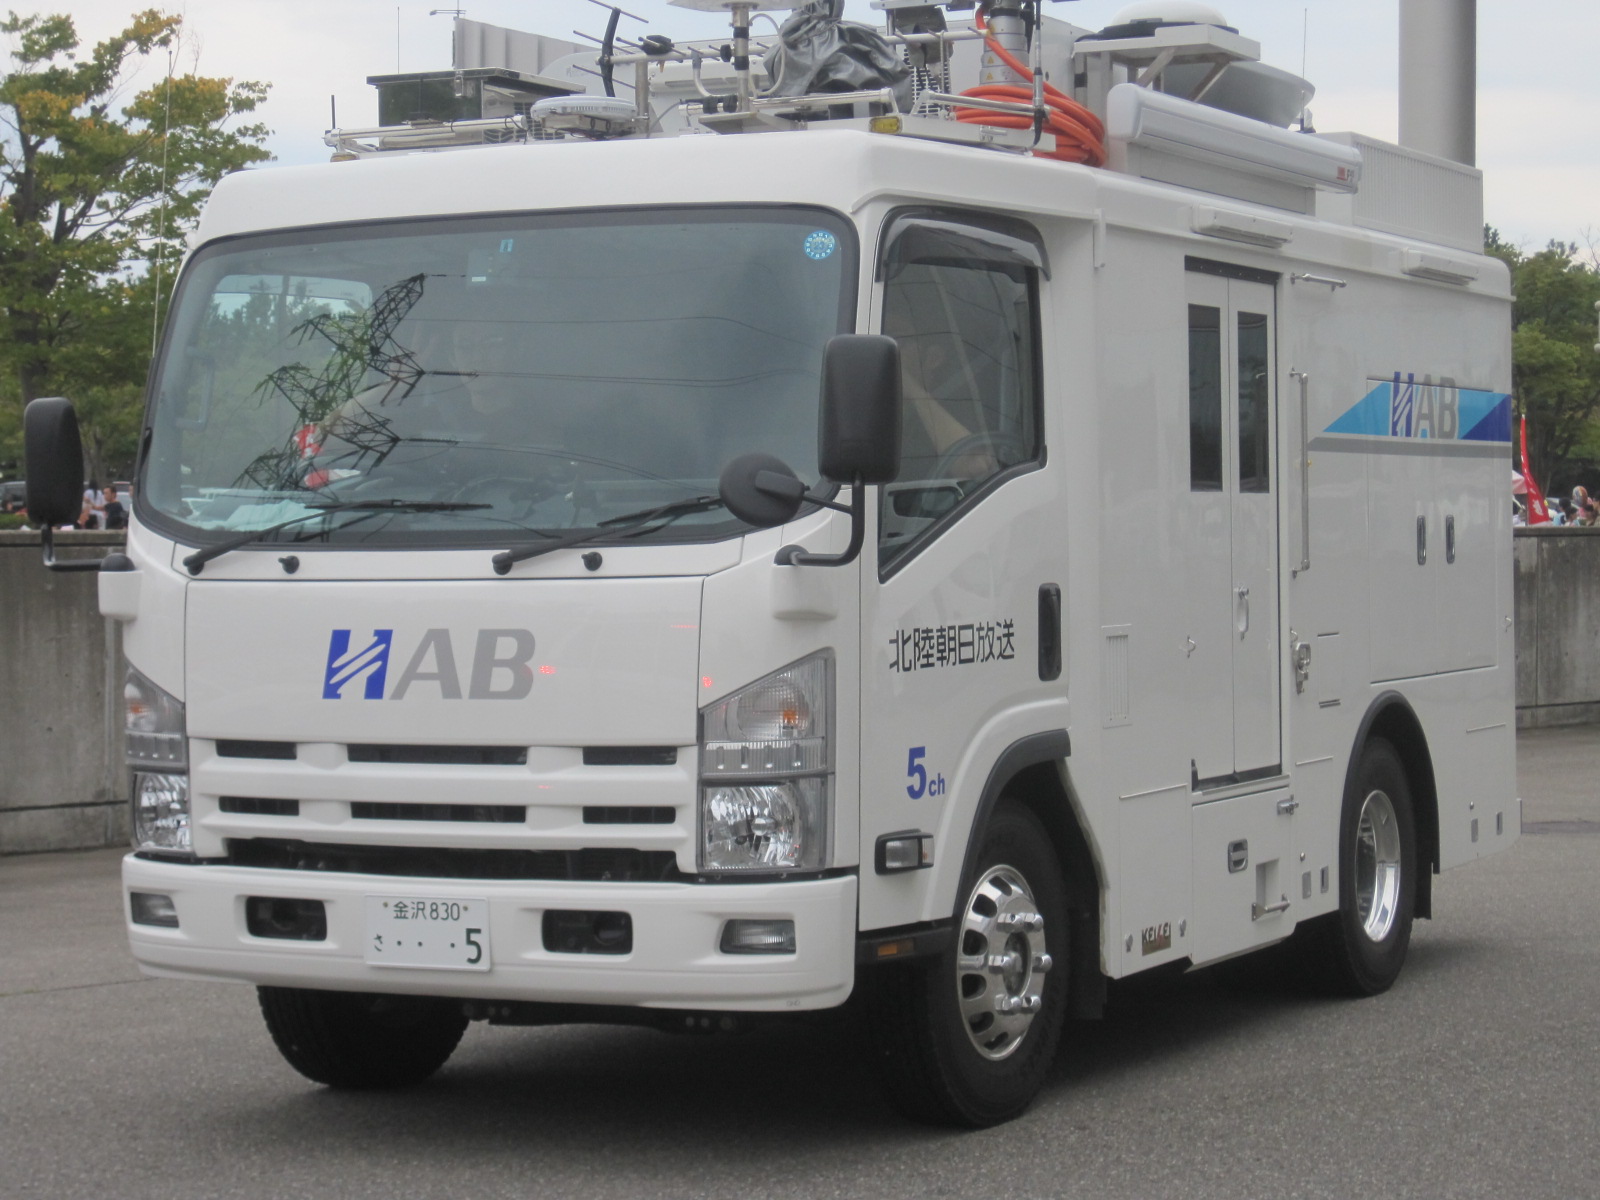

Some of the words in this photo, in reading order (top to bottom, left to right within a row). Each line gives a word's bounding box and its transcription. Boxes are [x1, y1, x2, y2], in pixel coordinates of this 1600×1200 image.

[1391, 371, 1457, 439] HAB
[322, 628, 536, 700] HAB
[888, 617, 1015, 673] 北陸朝日放送
[393, 901, 461, 921] 金沢830
